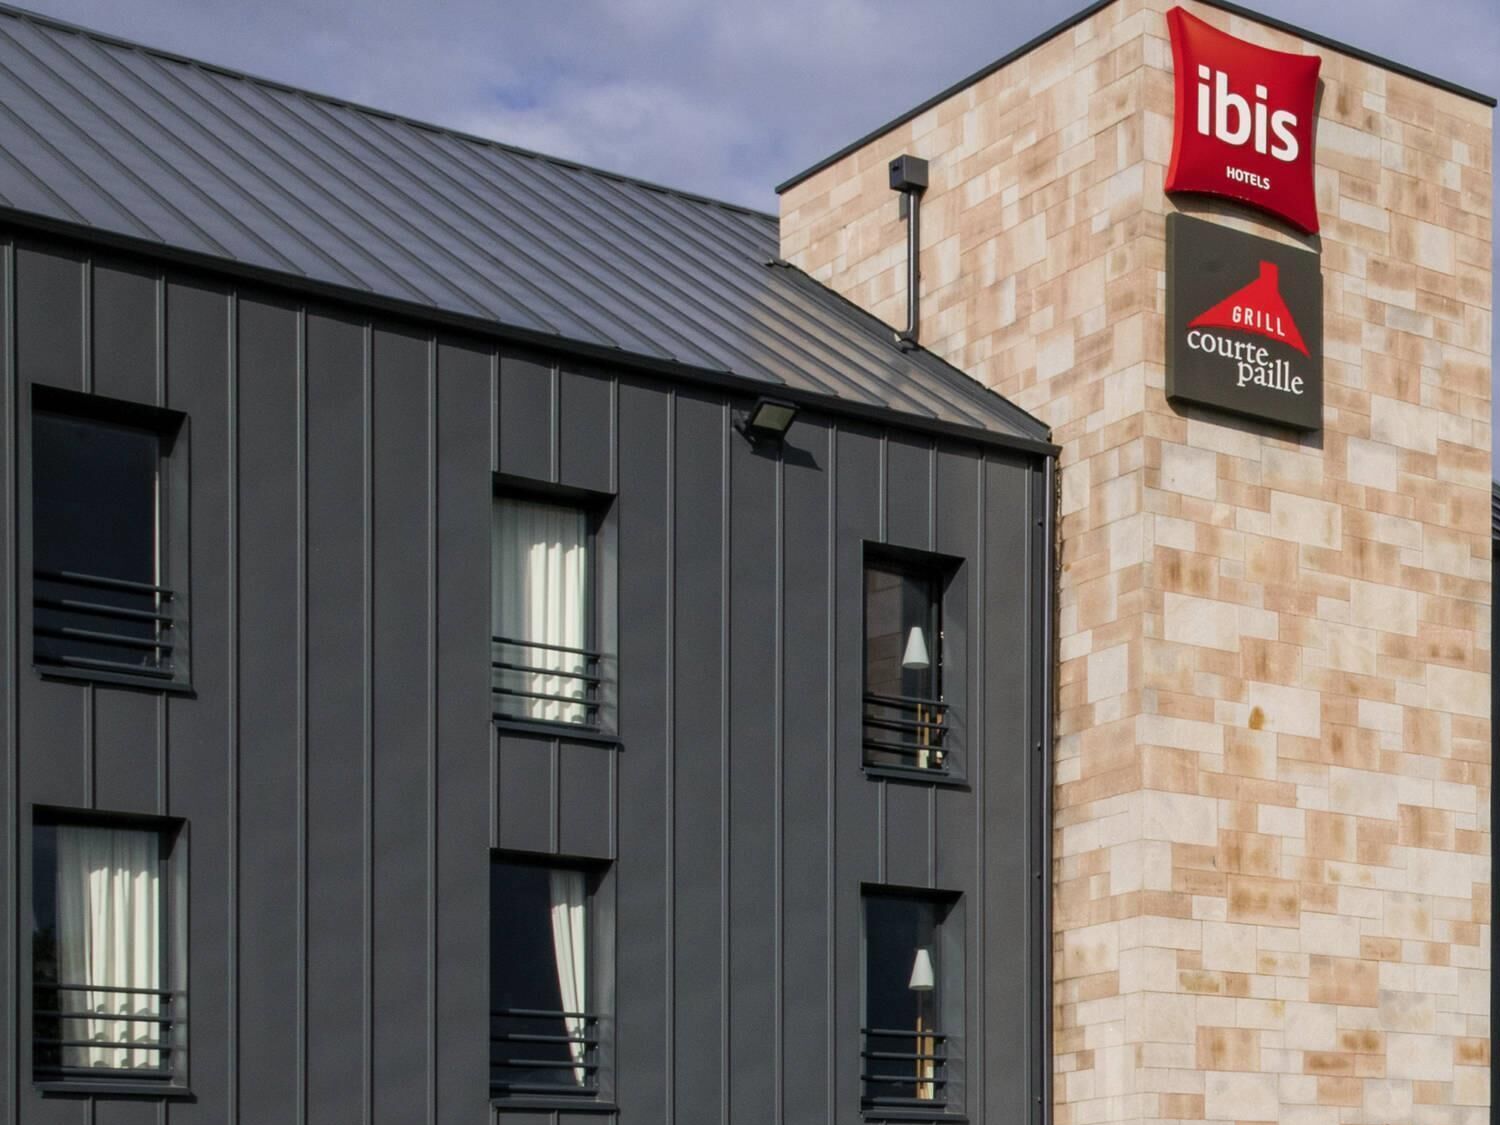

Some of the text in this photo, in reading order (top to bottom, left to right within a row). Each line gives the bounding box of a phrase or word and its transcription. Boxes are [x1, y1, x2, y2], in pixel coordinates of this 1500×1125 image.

[1197, 64, 1299, 162] ibis
[1225, 165, 1271, 191] HOTELS
[1232, 305, 1285, 337] GRILL
[1187, 329, 1270, 366] courte
[1237, 360, 1304, 394] paille
